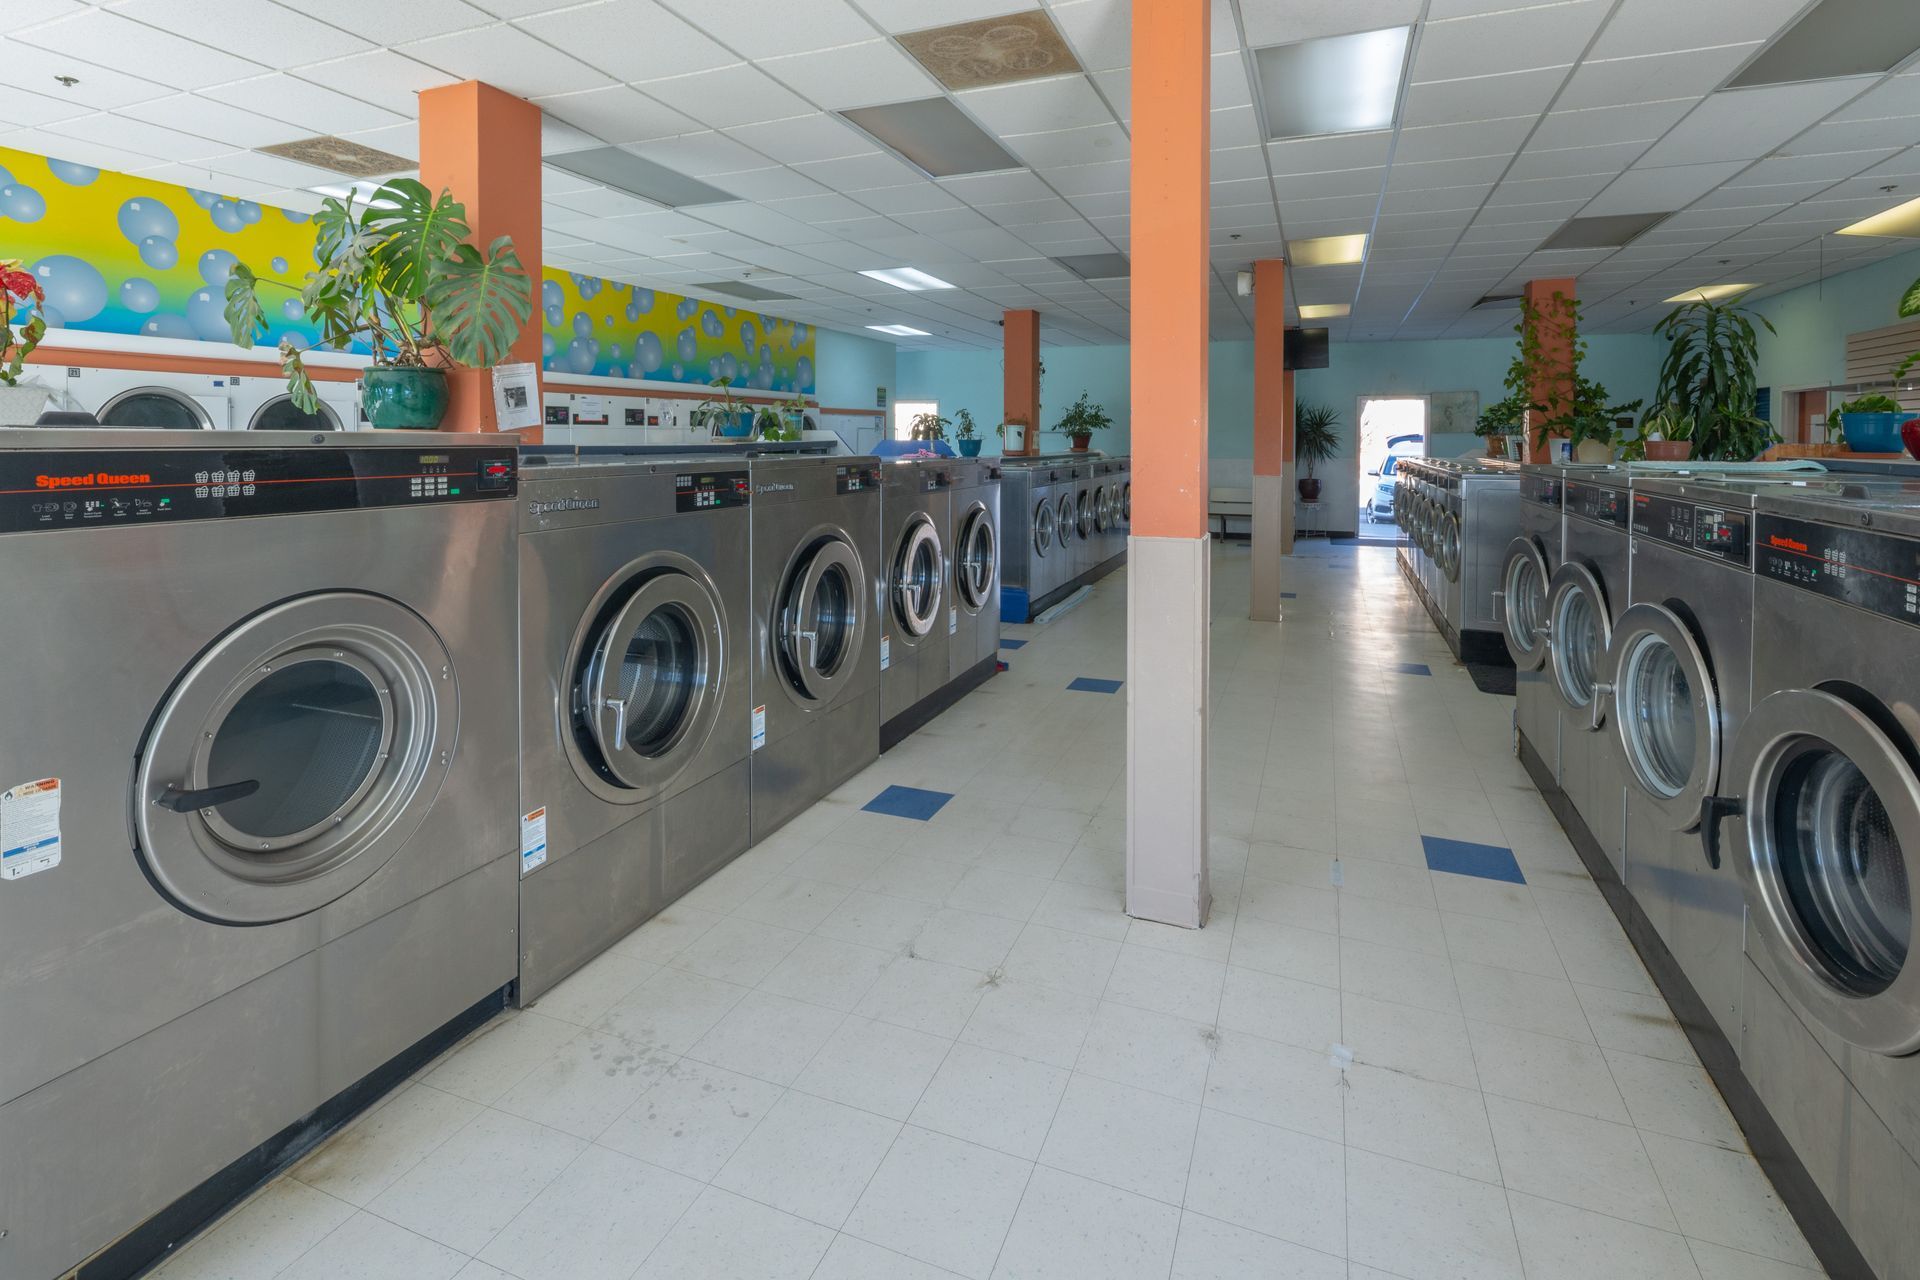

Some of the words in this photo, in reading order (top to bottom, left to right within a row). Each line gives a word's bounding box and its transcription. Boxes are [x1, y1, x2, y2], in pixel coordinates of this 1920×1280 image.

[35, 473, 94, 489] Speed
[97, 472, 151, 485] Queen
[529, 498, 566, 515] Speed
[566, 497, 600, 511] Queen
